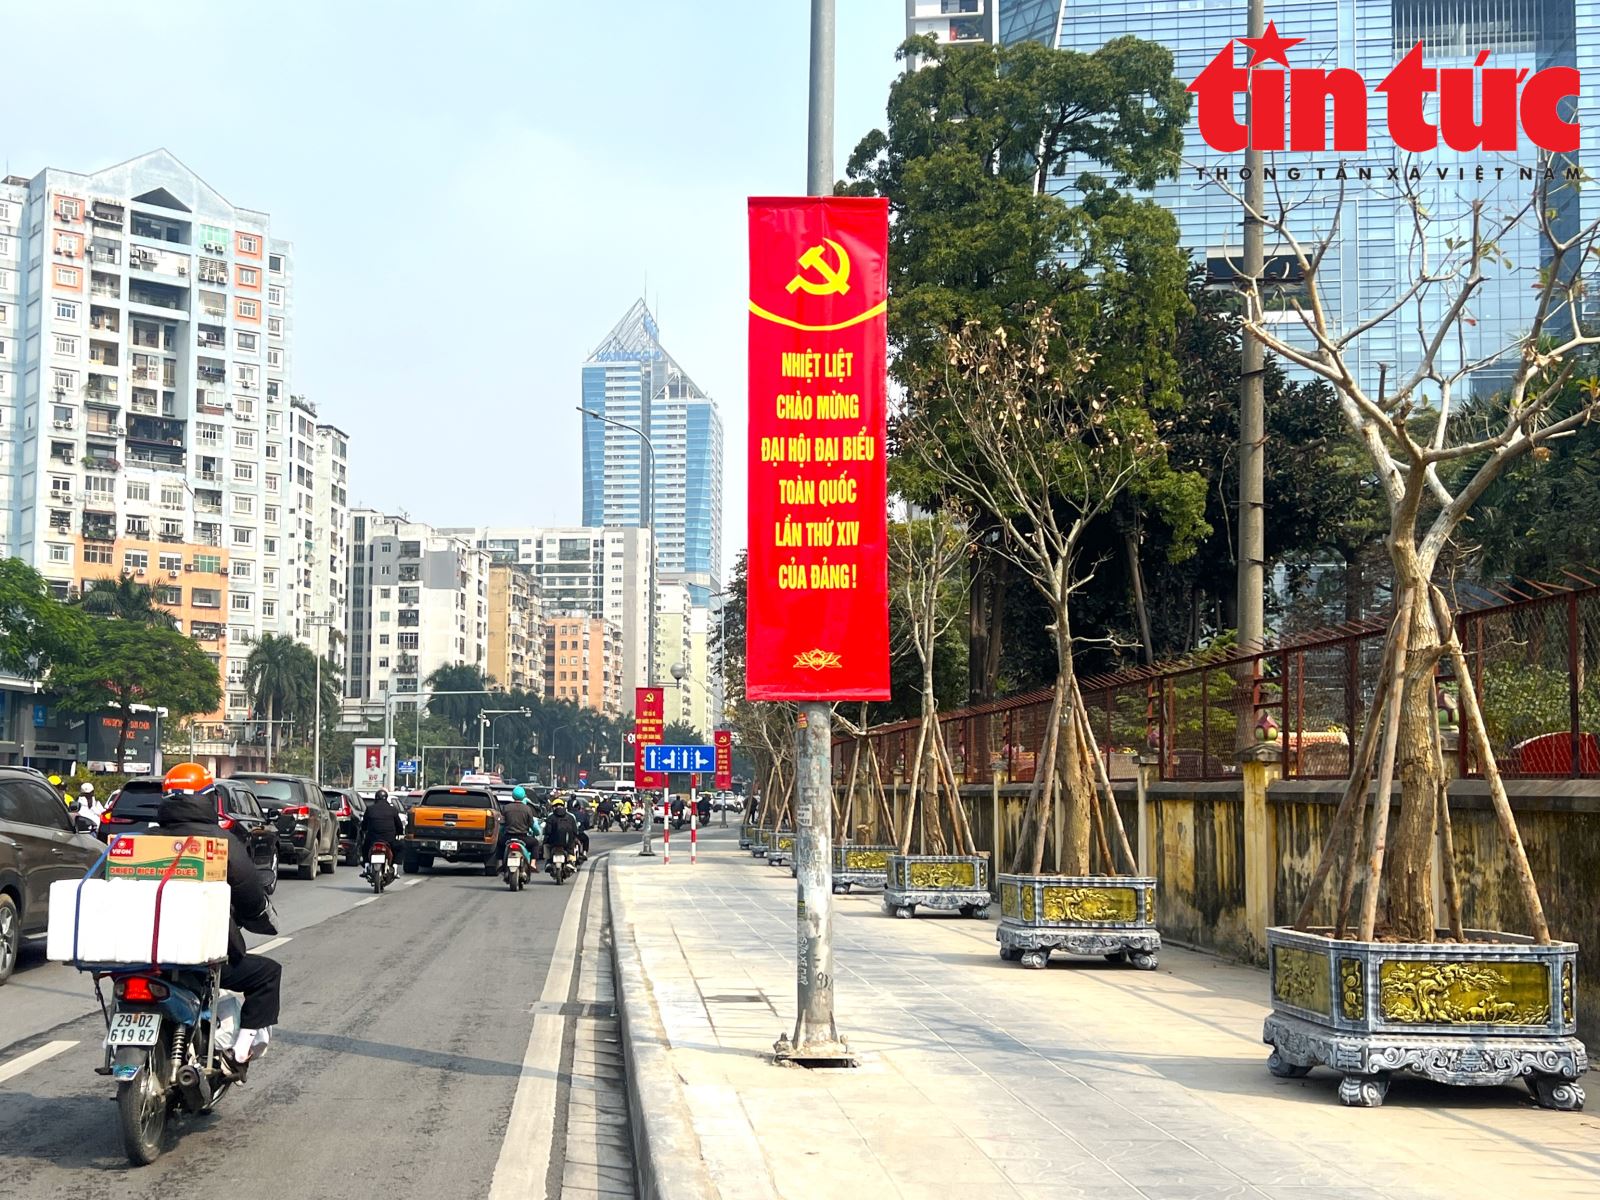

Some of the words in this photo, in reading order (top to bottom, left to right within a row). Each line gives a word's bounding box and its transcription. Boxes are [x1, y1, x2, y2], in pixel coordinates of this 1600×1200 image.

[781, 347, 822, 384] NHIỆT
[824, 347, 854, 383] LIỆT
[775, 389, 813, 421] CHÀO
[816, 389, 860, 421] MỪNG
[760, 436, 785, 467] ĐẠI
[787, 432, 812, 469] HỘI
[814, 436, 839, 468] ĐẠI
[842, 425, 875, 462] BIỂU
[778, 474, 816, 505] TOÀN
[818, 469, 858, 508] QUỐC
[775, 513, 803, 548] LẦN
[805, 516, 835, 548] THỨ
[836, 520, 860, 547] XIV
[778, 556, 808, 590] CỦA
[109, 866, 135, 875] DRIED
[136, 867, 156, 875] RICE
[157, 867, 197, 877] NDLES
